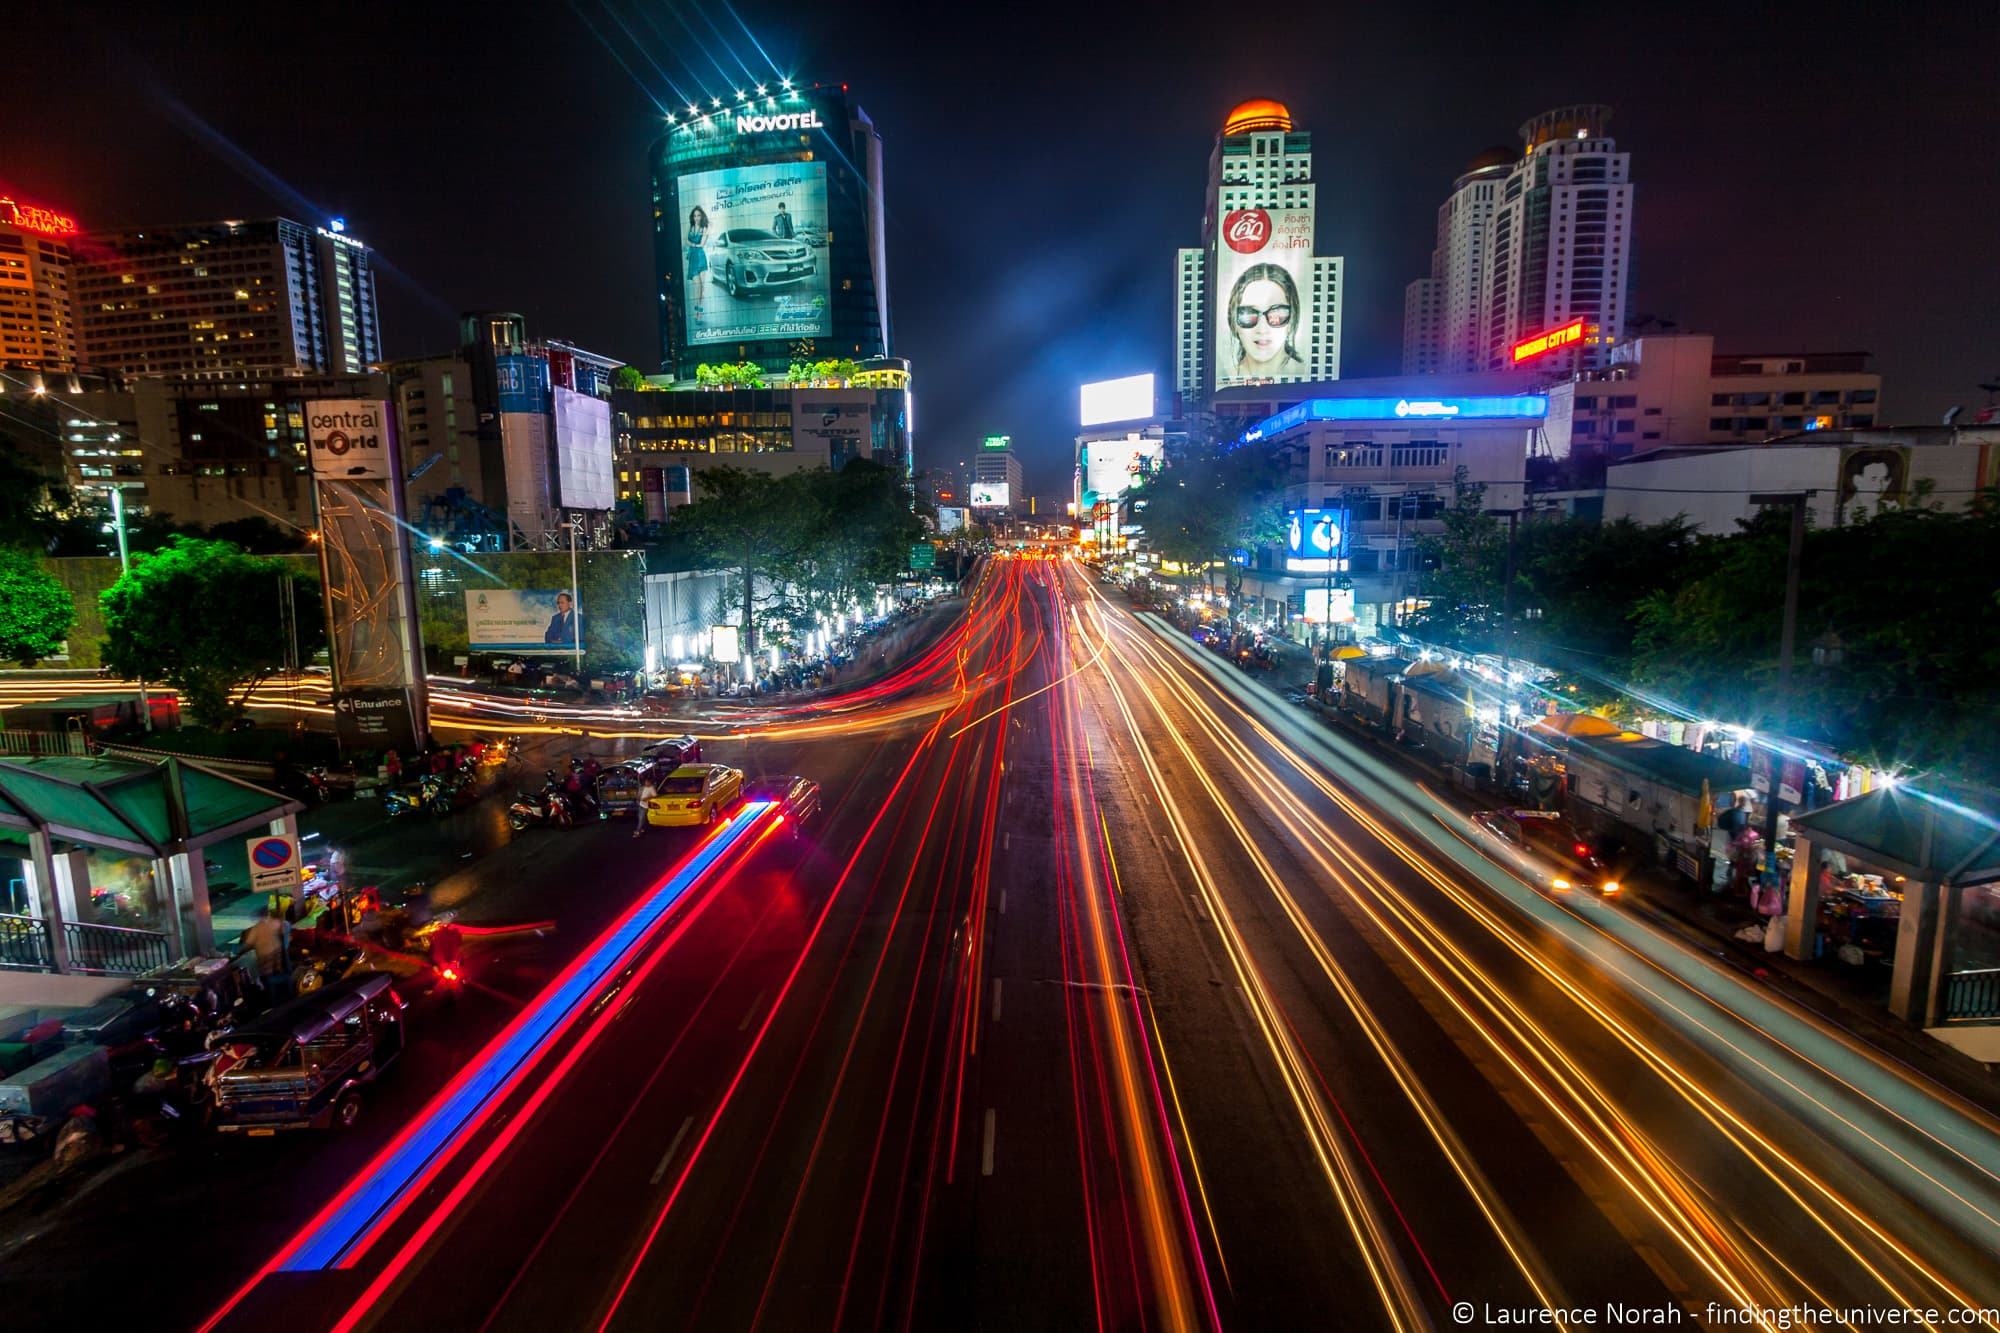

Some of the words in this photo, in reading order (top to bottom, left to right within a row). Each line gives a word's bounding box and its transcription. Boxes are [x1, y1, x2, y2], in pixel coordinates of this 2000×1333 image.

[737, 109, 823, 134] NOVOTEL
[21, 206, 74, 229] GRAND
[311, 410, 379, 428] central
[313, 430, 379, 456] world
[354, 699, 402, 708] Entrance
